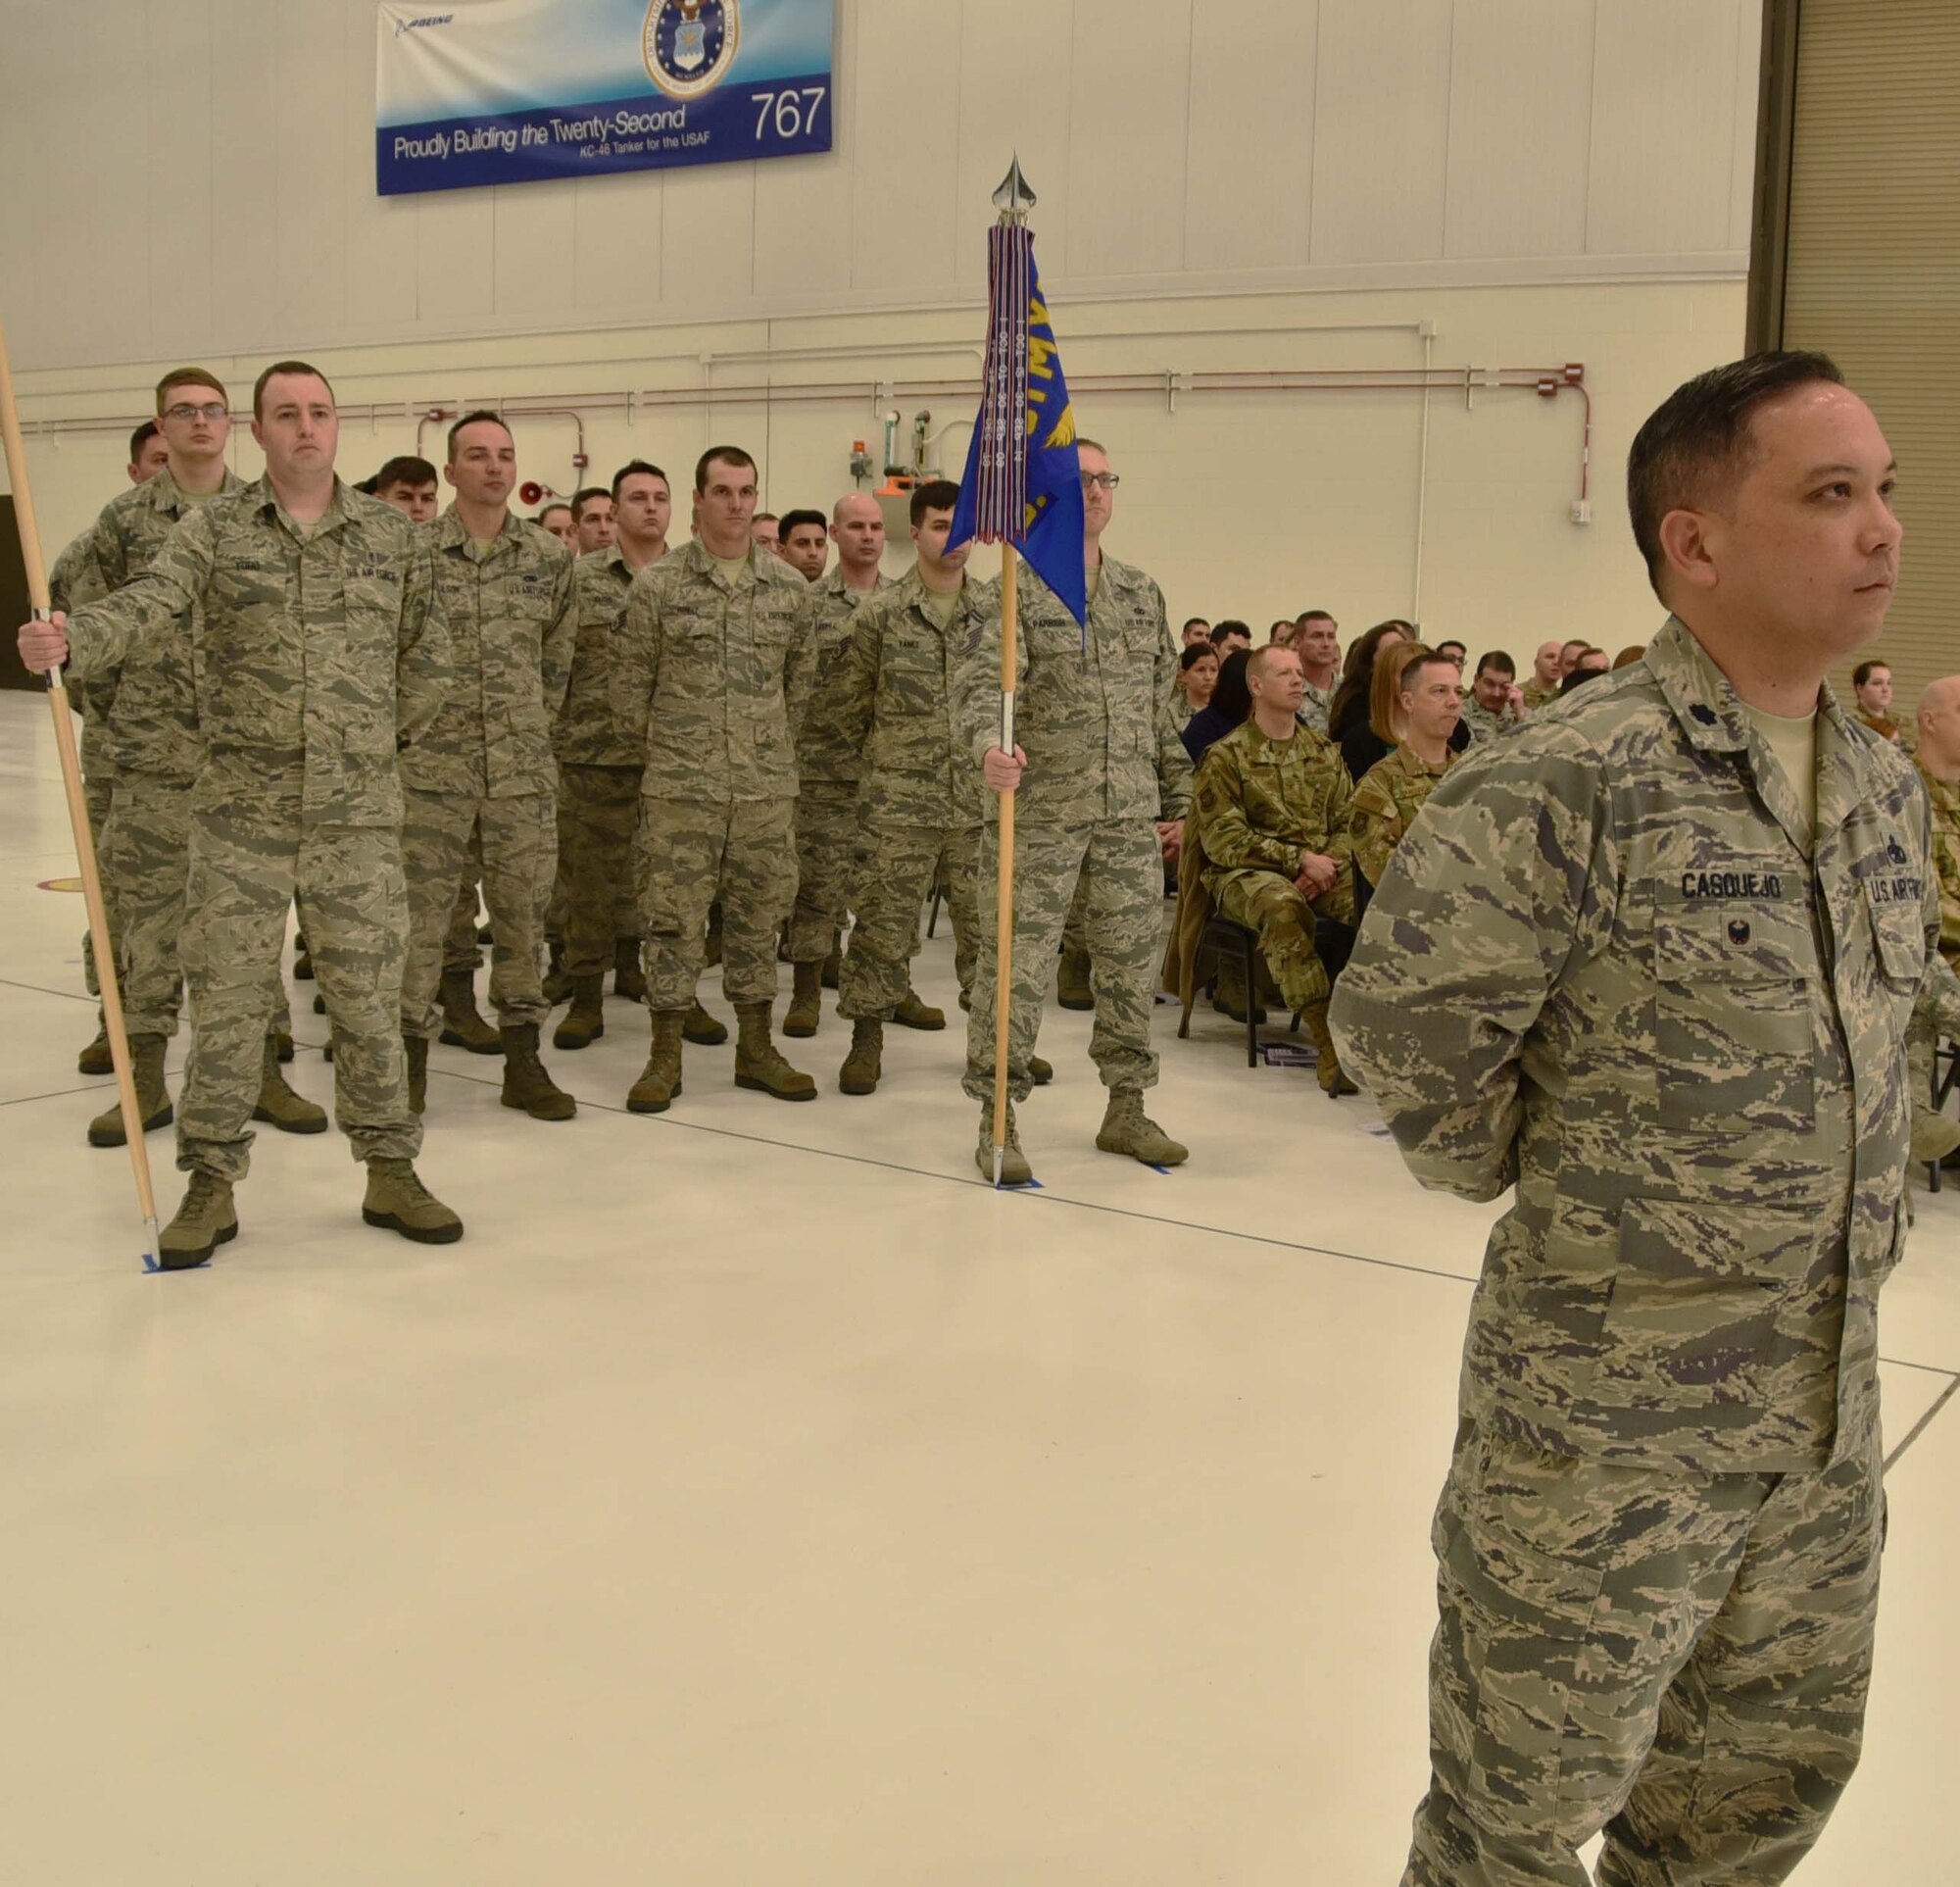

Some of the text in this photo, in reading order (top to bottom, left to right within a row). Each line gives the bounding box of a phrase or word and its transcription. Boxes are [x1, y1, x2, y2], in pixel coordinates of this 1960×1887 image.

[394, 103, 686, 160] Proudly Building the Twenty-Second
[751, 86, 825, 140] 767
[579, 130, 710, 159] KC-46 Tanker for the USAF
[1681, 872, 1782, 898] CASQUEJO
